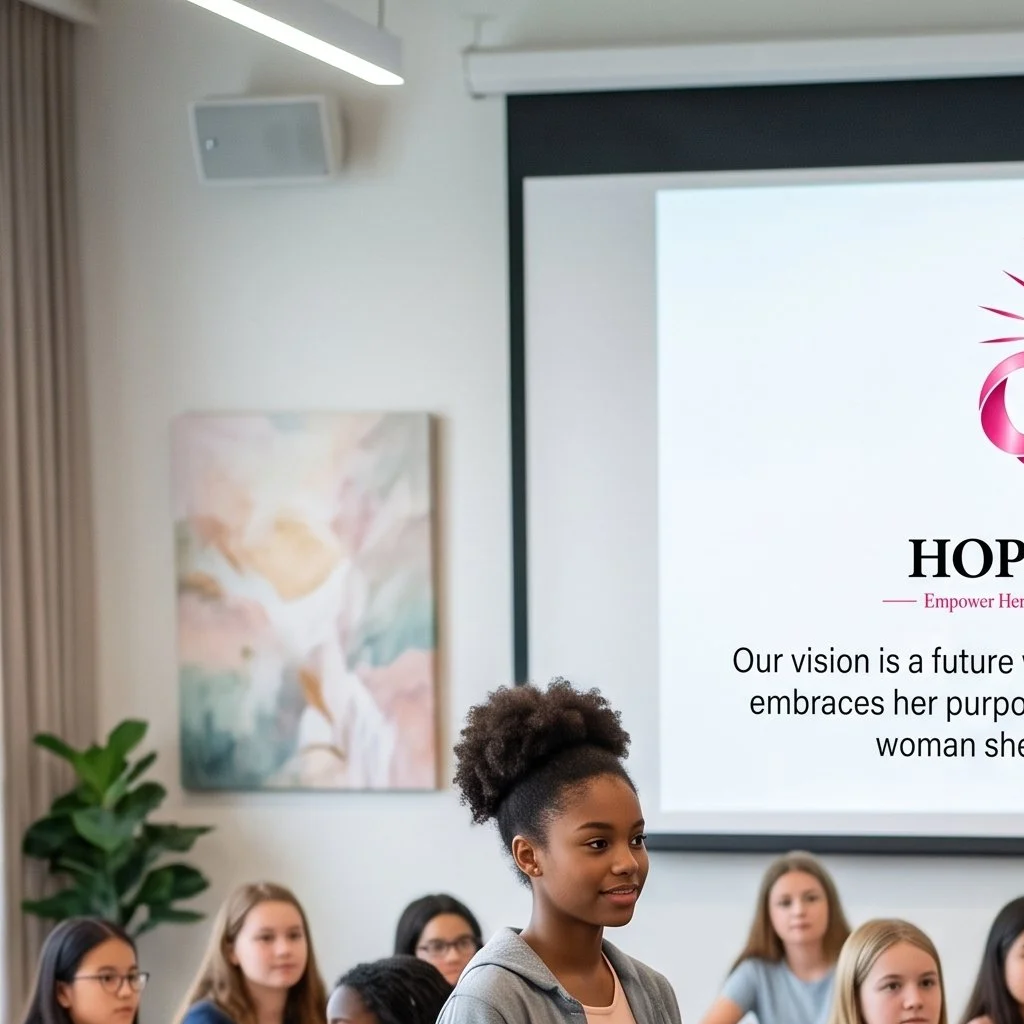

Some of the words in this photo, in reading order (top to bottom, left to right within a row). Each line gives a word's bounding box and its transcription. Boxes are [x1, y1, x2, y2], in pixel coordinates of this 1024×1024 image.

[924, 592, 995, 613] Empower
[733, 646, 784, 674] Our
[790, 646, 870, 674] vision
[879, 646, 900, 674] is
[908, 653, 923, 674] a
[931, 646, 1014, 675] future
[749, 687, 885, 716] embraces
[894, 688, 939, 716] her
[875, 737, 976, 758] woman
